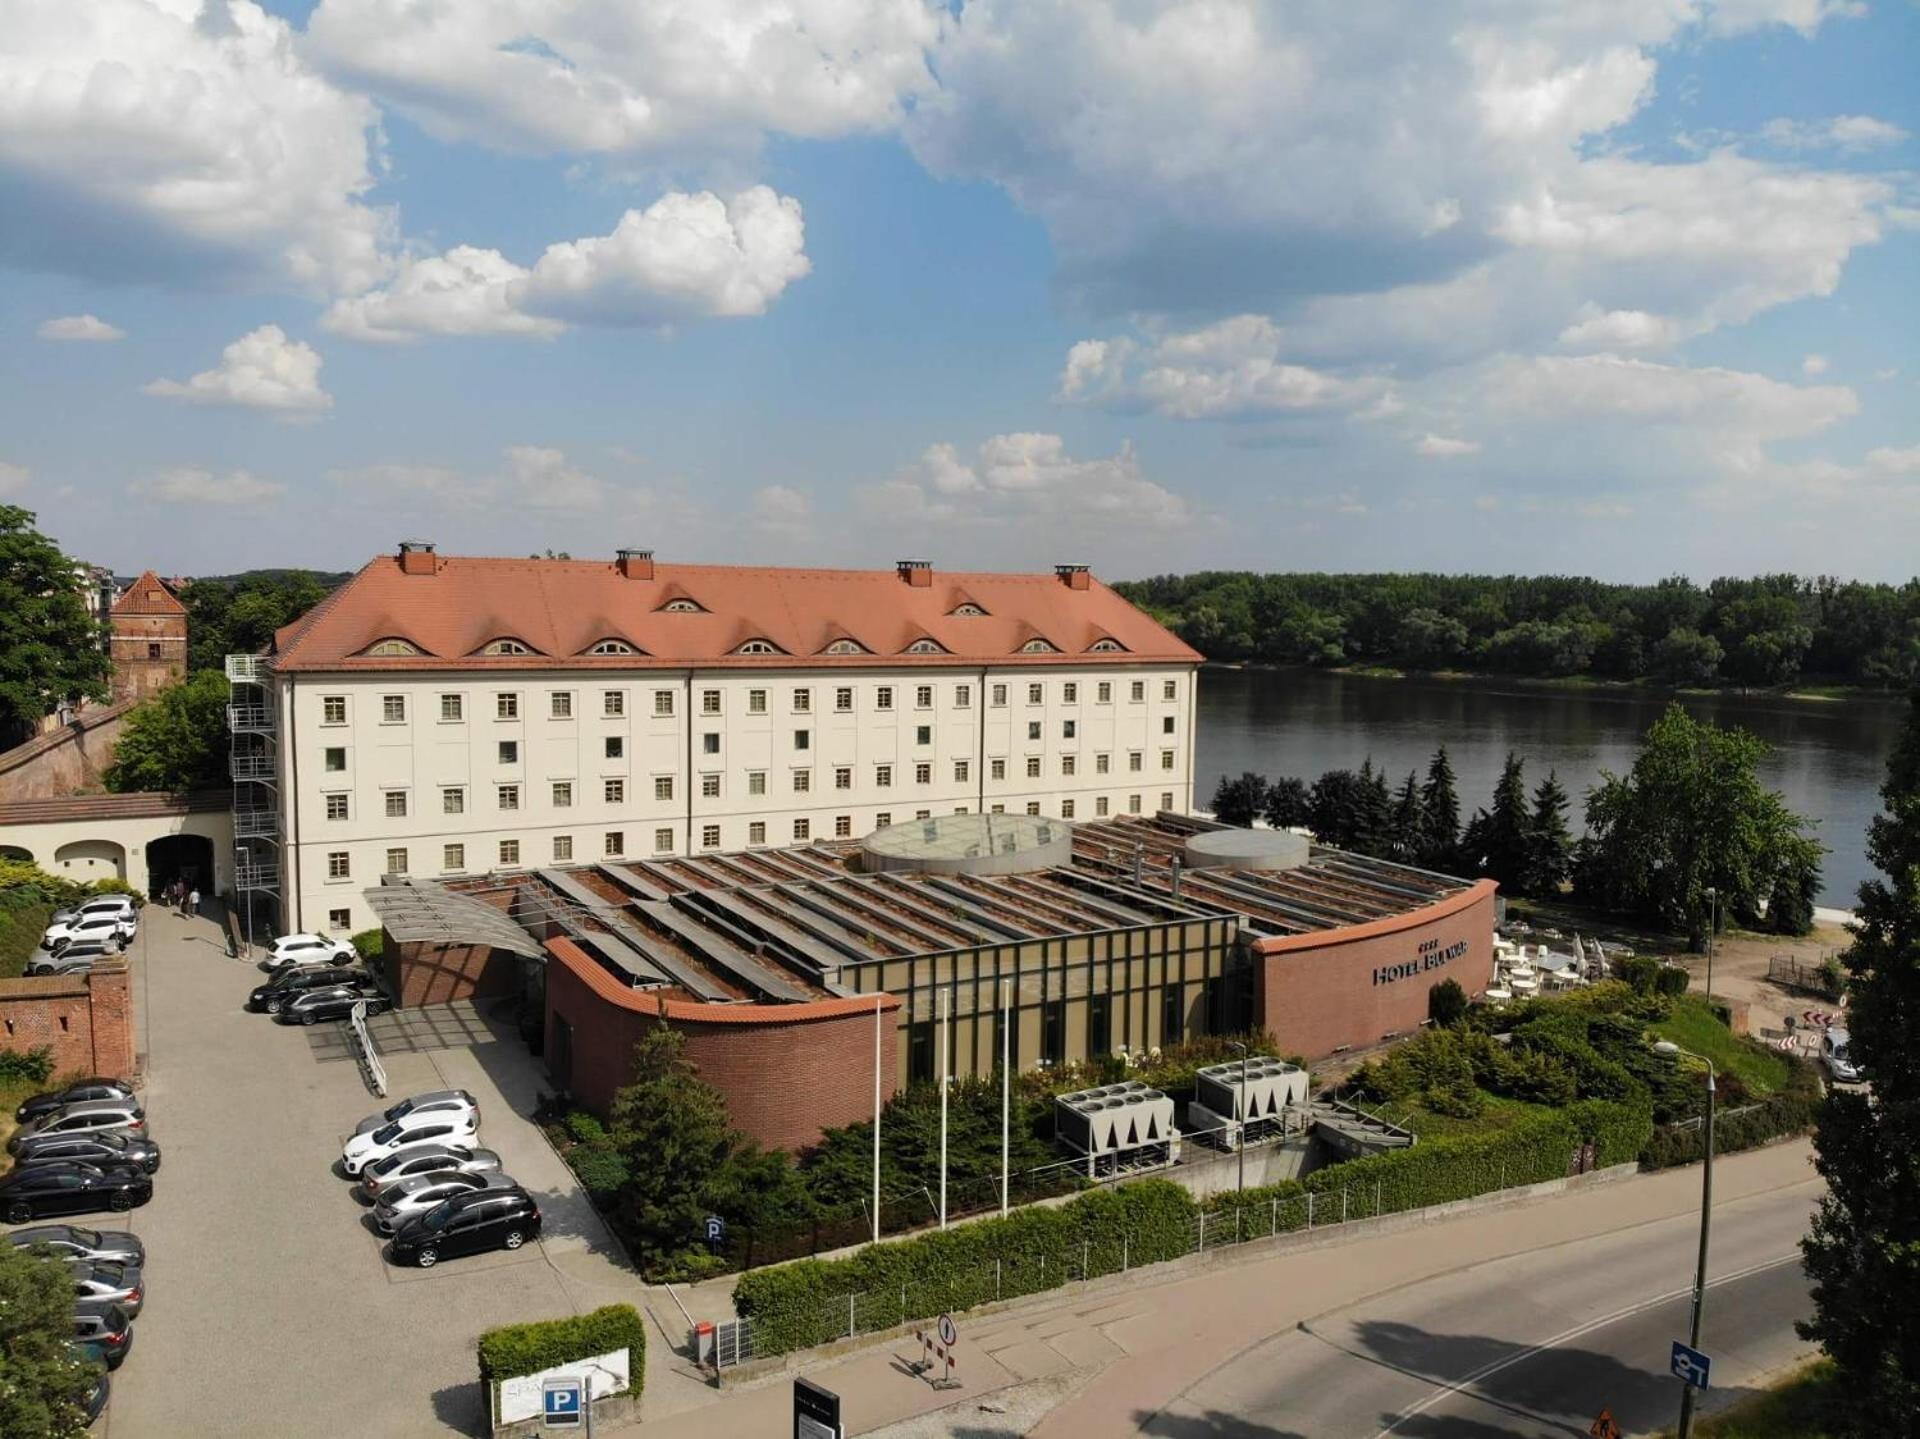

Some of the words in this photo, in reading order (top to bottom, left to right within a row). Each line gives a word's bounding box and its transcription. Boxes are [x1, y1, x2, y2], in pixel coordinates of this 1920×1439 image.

[1373, 960, 1420, 986] HOTEL
[1424, 941, 1469, 971] BULWAR
[709, 1223, 719, 1238] P
[554, 1392, 571, 1411] P
